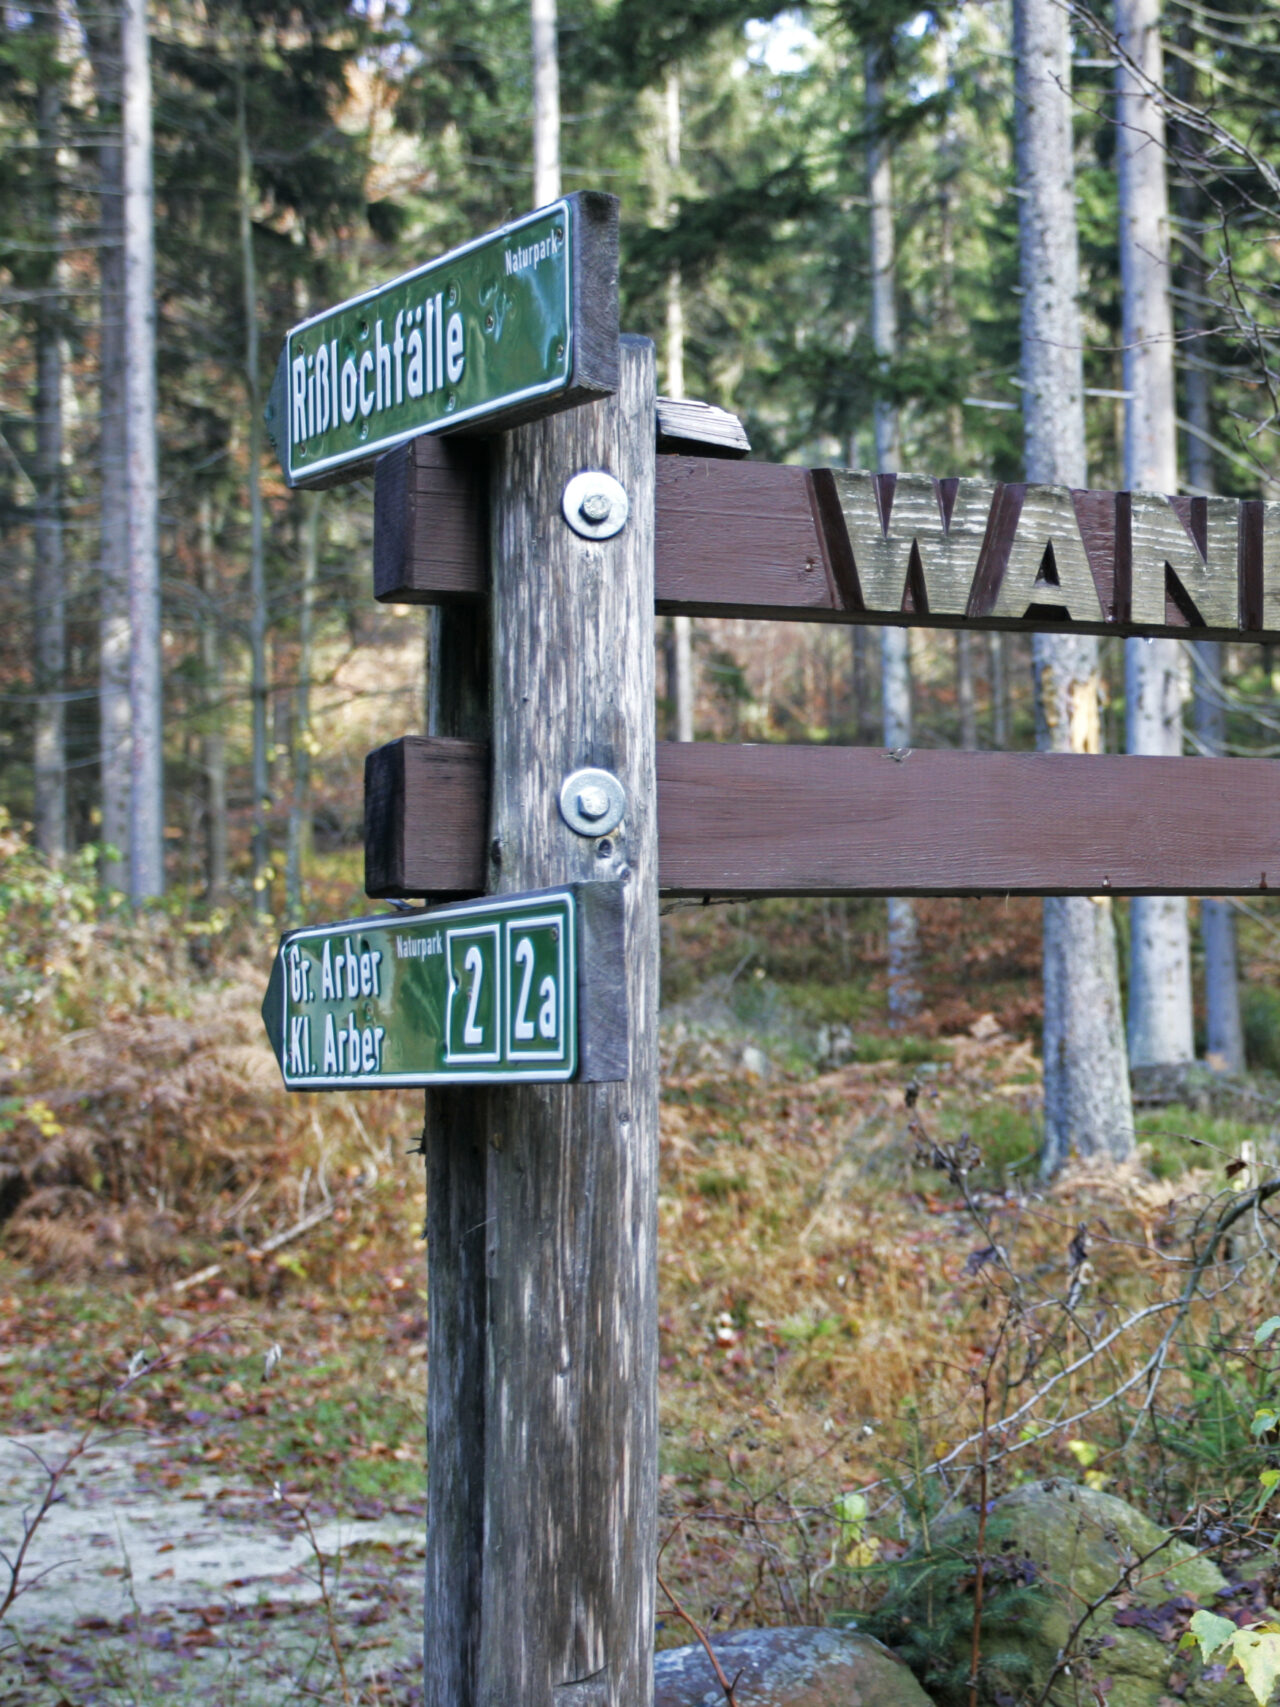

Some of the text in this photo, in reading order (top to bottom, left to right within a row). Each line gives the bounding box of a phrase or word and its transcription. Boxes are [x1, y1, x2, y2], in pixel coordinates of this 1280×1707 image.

[505, 229, 558, 276] Naturpark
[292, 292, 464, 444] Rißlochfälle
[290, 938, 382, 1003] Gr. Arber
[396, 930, 443, 962] Naturpark
[463, 937, 557, 1045] 2 2a
[290, 1012, 386, 1075] Kl. Arber
